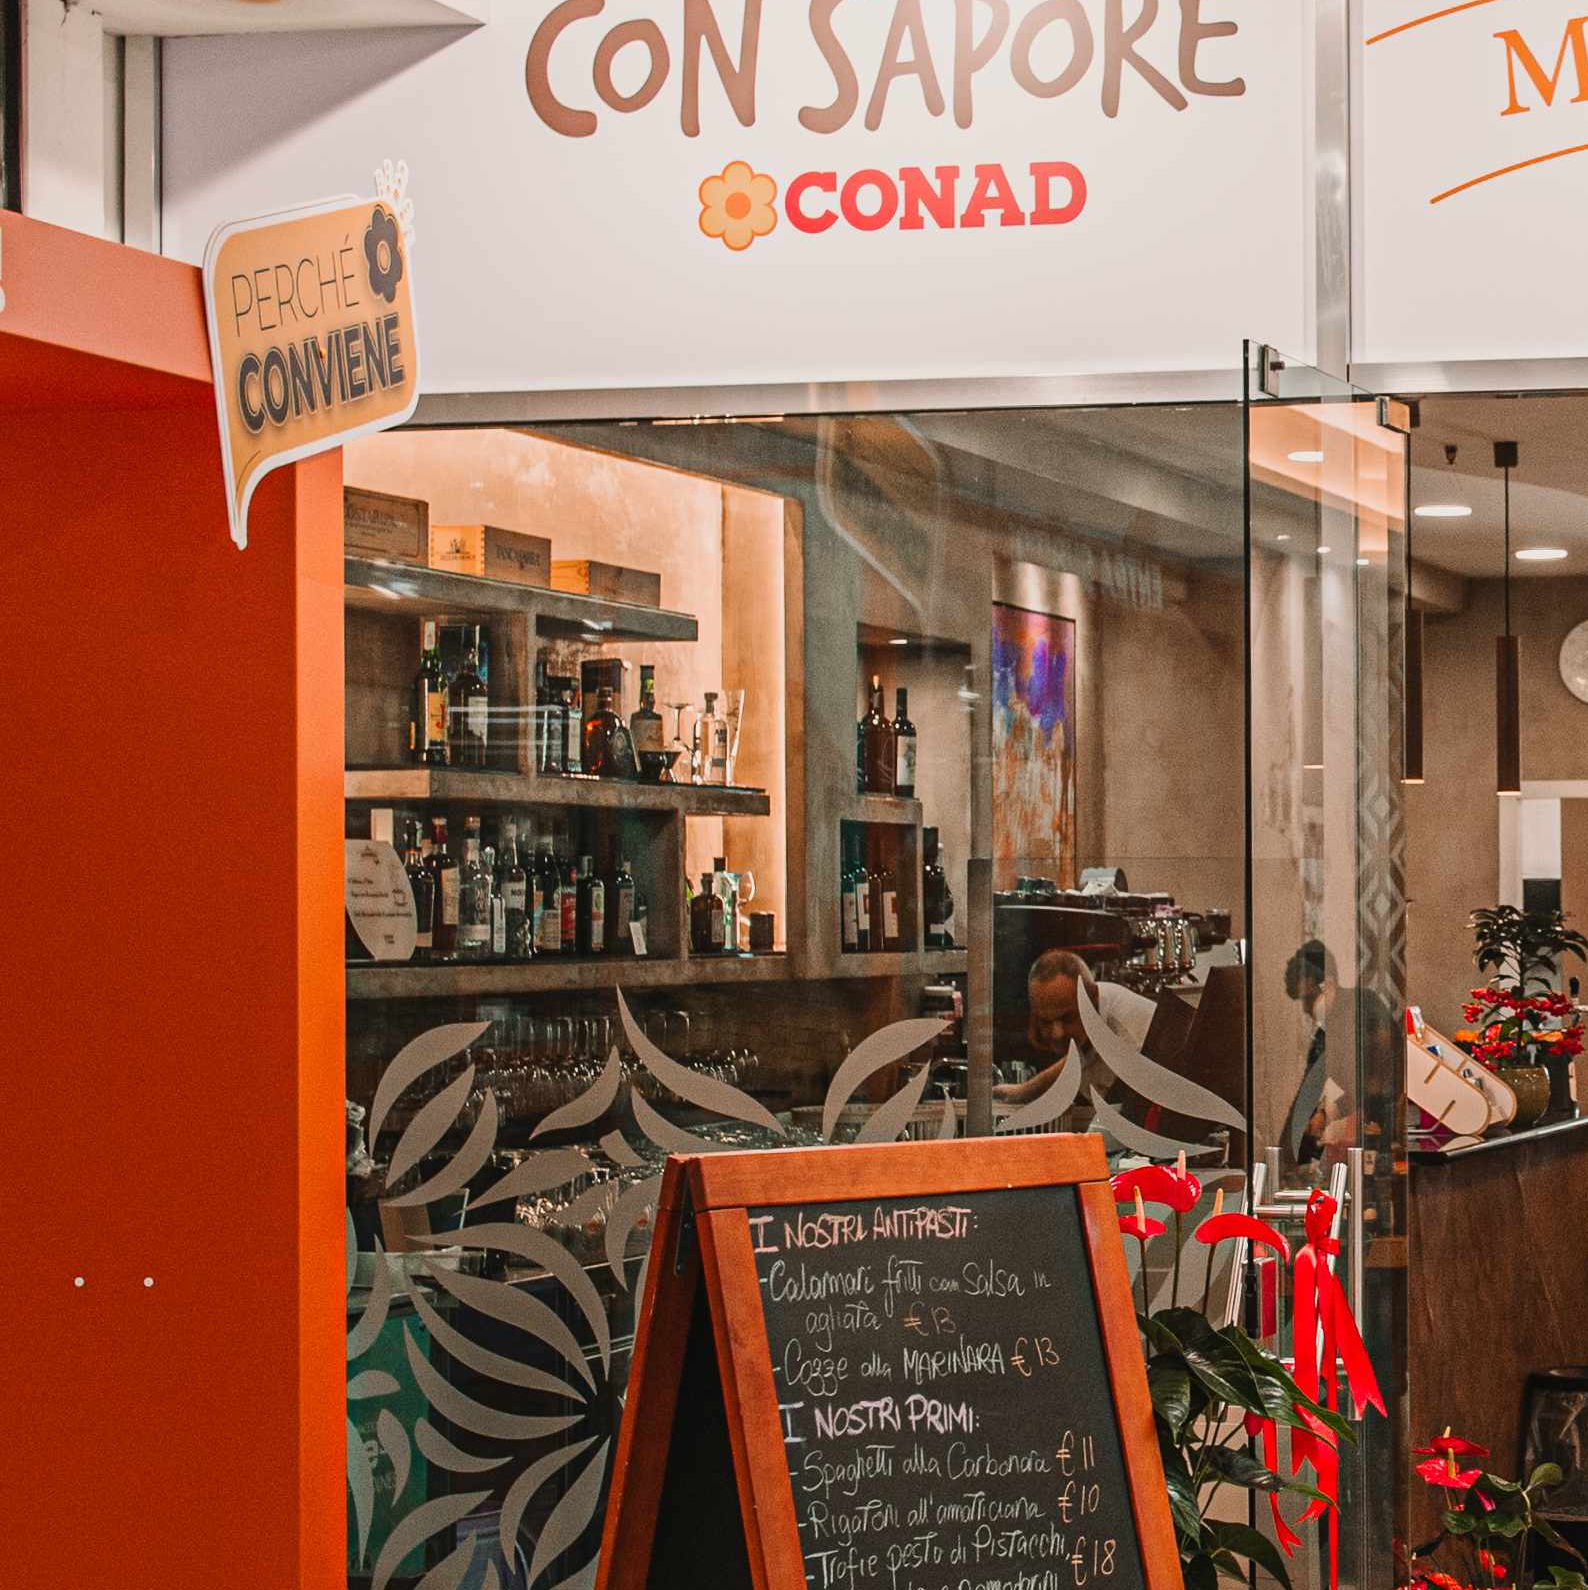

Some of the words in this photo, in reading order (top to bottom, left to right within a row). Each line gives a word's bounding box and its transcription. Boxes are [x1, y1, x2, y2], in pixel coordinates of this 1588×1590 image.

[784, 161, 1088, 234] CONAD
[231, 234, 360, 337] PERCHÉ
[238, 312, 406, 434] CONVIENE
[749, 1215, 779, 1252] I
[784, 1212, 868, 1249] NOSTRI
[769, 1259, 875, 1302] Calamari
[806, 1300, 882, 1352] agliata
[784, 1338, 848, 1397] Cozze
[860, 1351, 892, 1382] alla
[903, 1334, 1005, 1385] MARINARA
[778, 1401, 807, 1444] I
[814, 1396, 900, 1440] NOSTRI
[905, 1393, 981, 1434] PRIMI:
[802, 1445, 896, 1499] Spaghetti
[903, 1442, 942, 1478] alla
[947, 1441, 1051, 1480] Carbonara
[807, 1499, 900, 1546] Rigatoni
[951, 1534, 967, 1565] di
